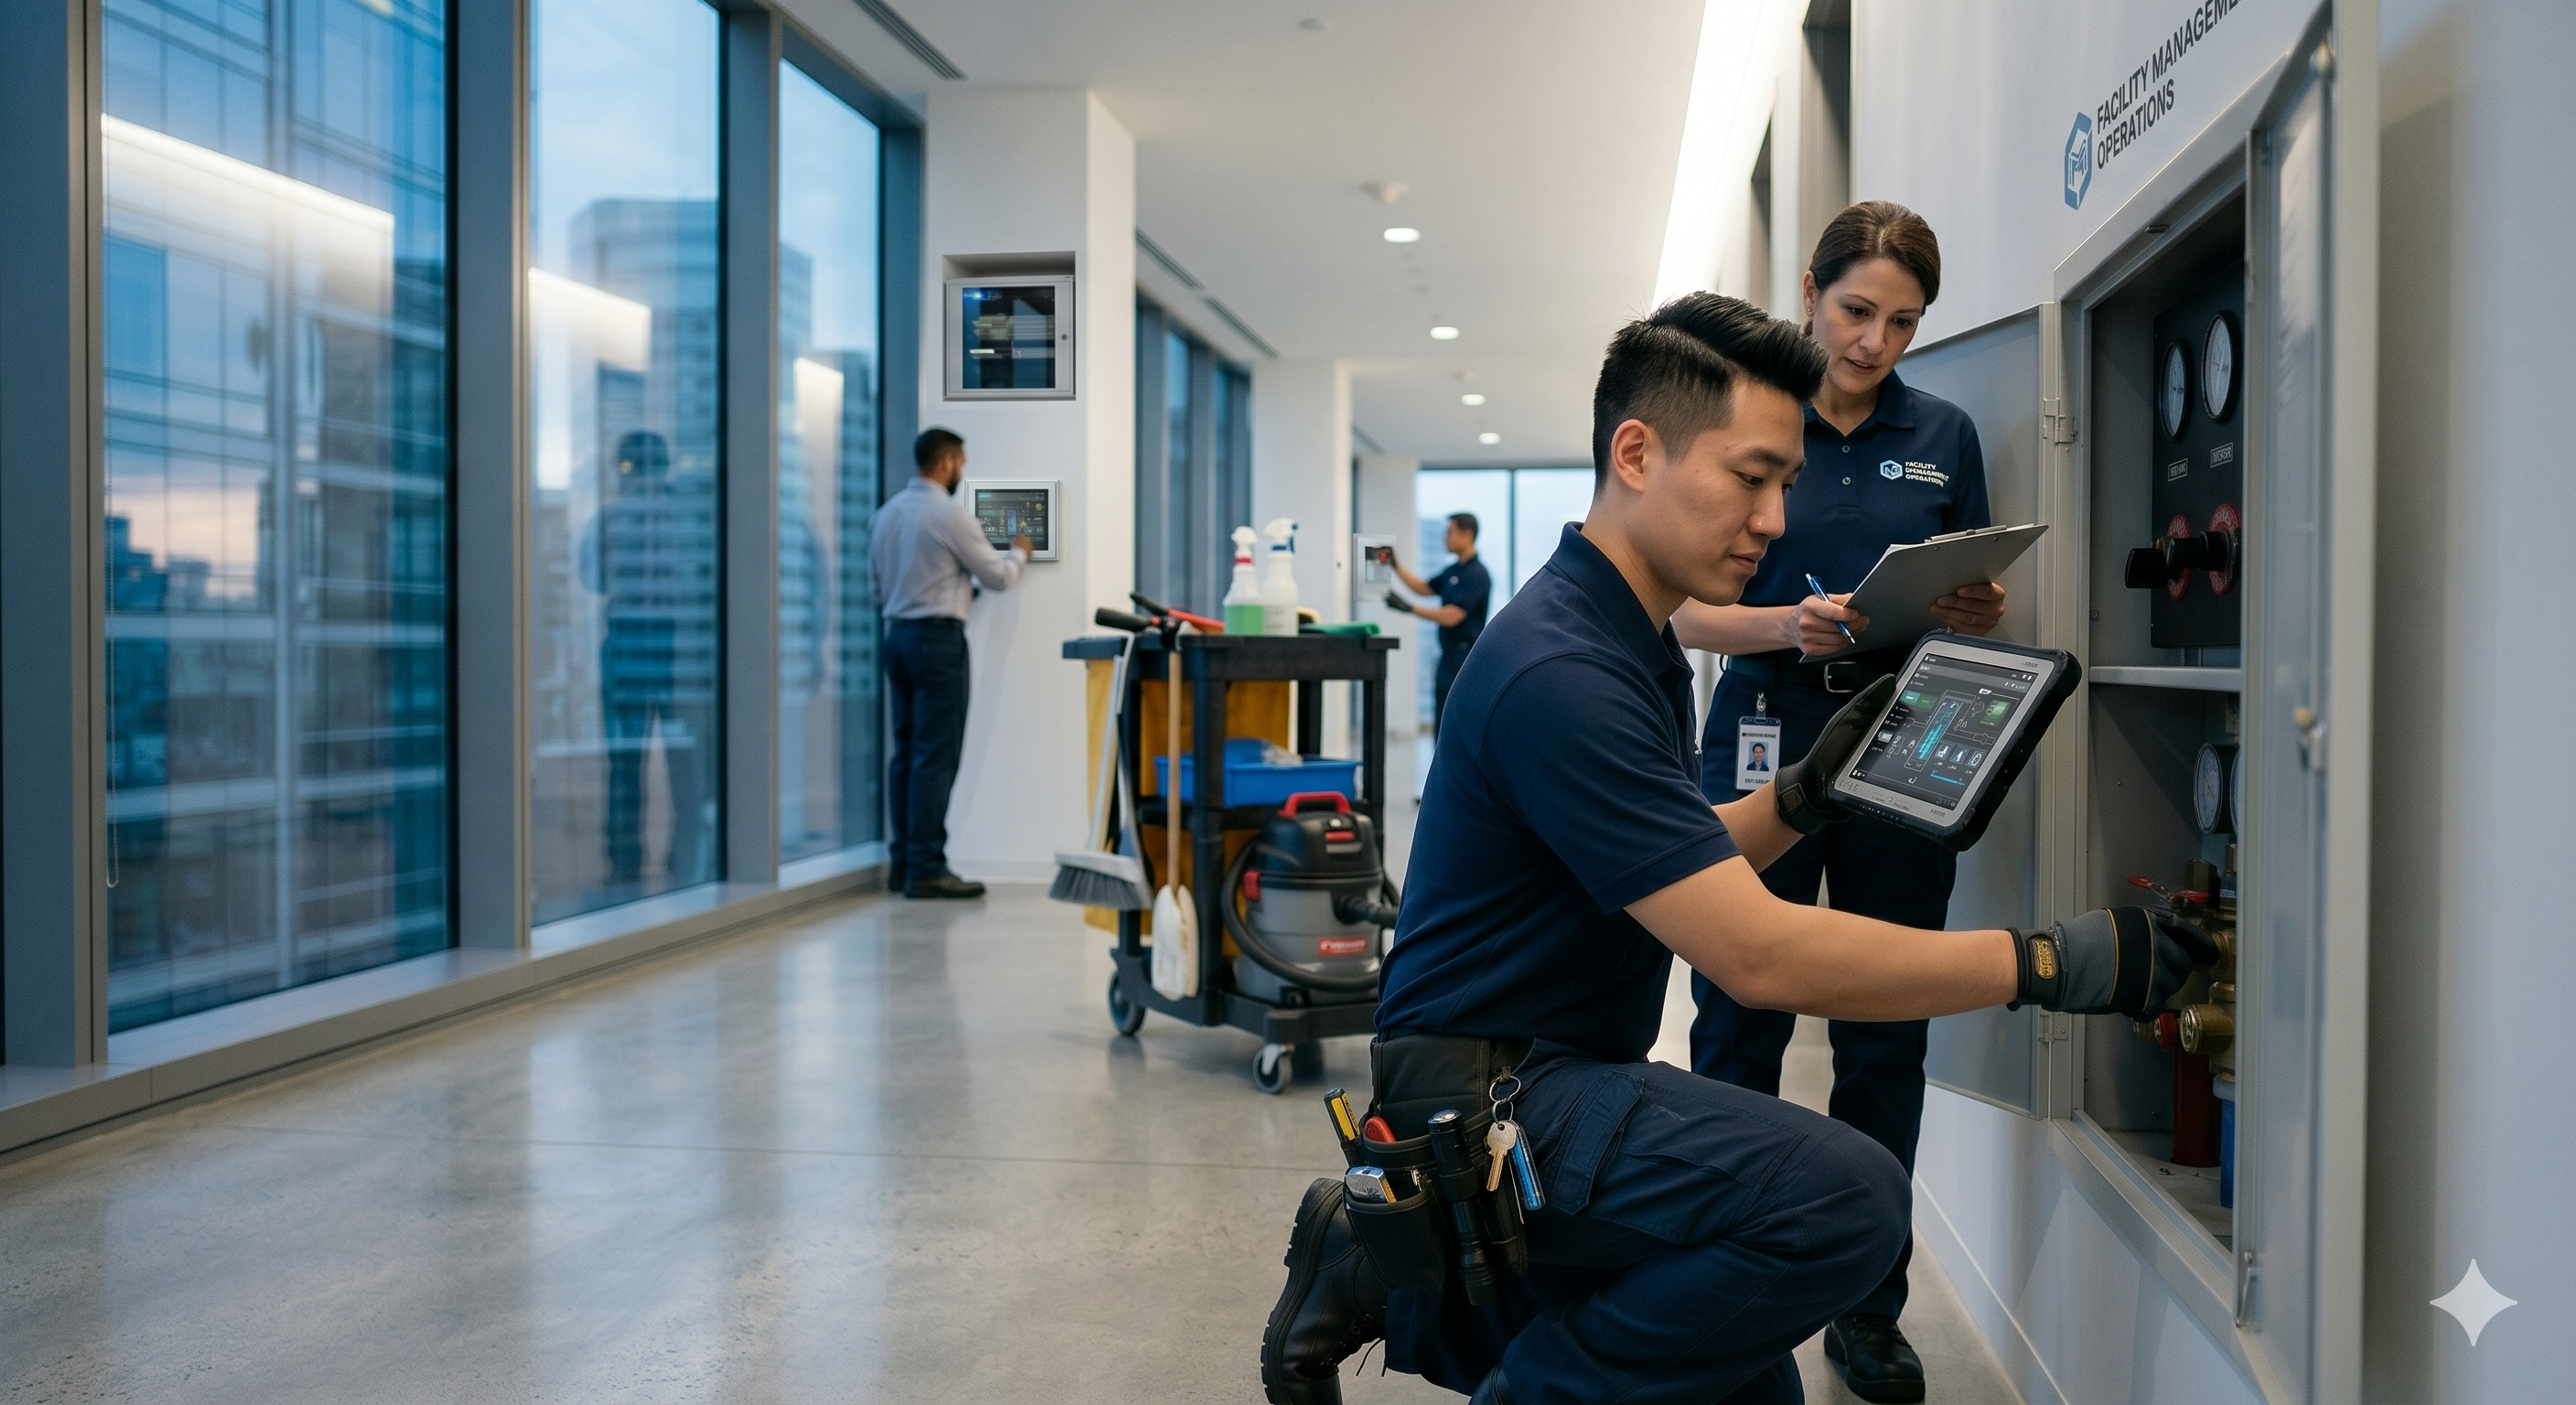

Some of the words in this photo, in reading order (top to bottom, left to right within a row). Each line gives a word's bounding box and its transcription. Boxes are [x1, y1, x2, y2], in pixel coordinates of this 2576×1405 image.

[2098, 59, 2149, 134] FACILITY
[2098, 79, 2174, 169] OPERATIONS
[1905, 461, 1937, 470] FACILITY
